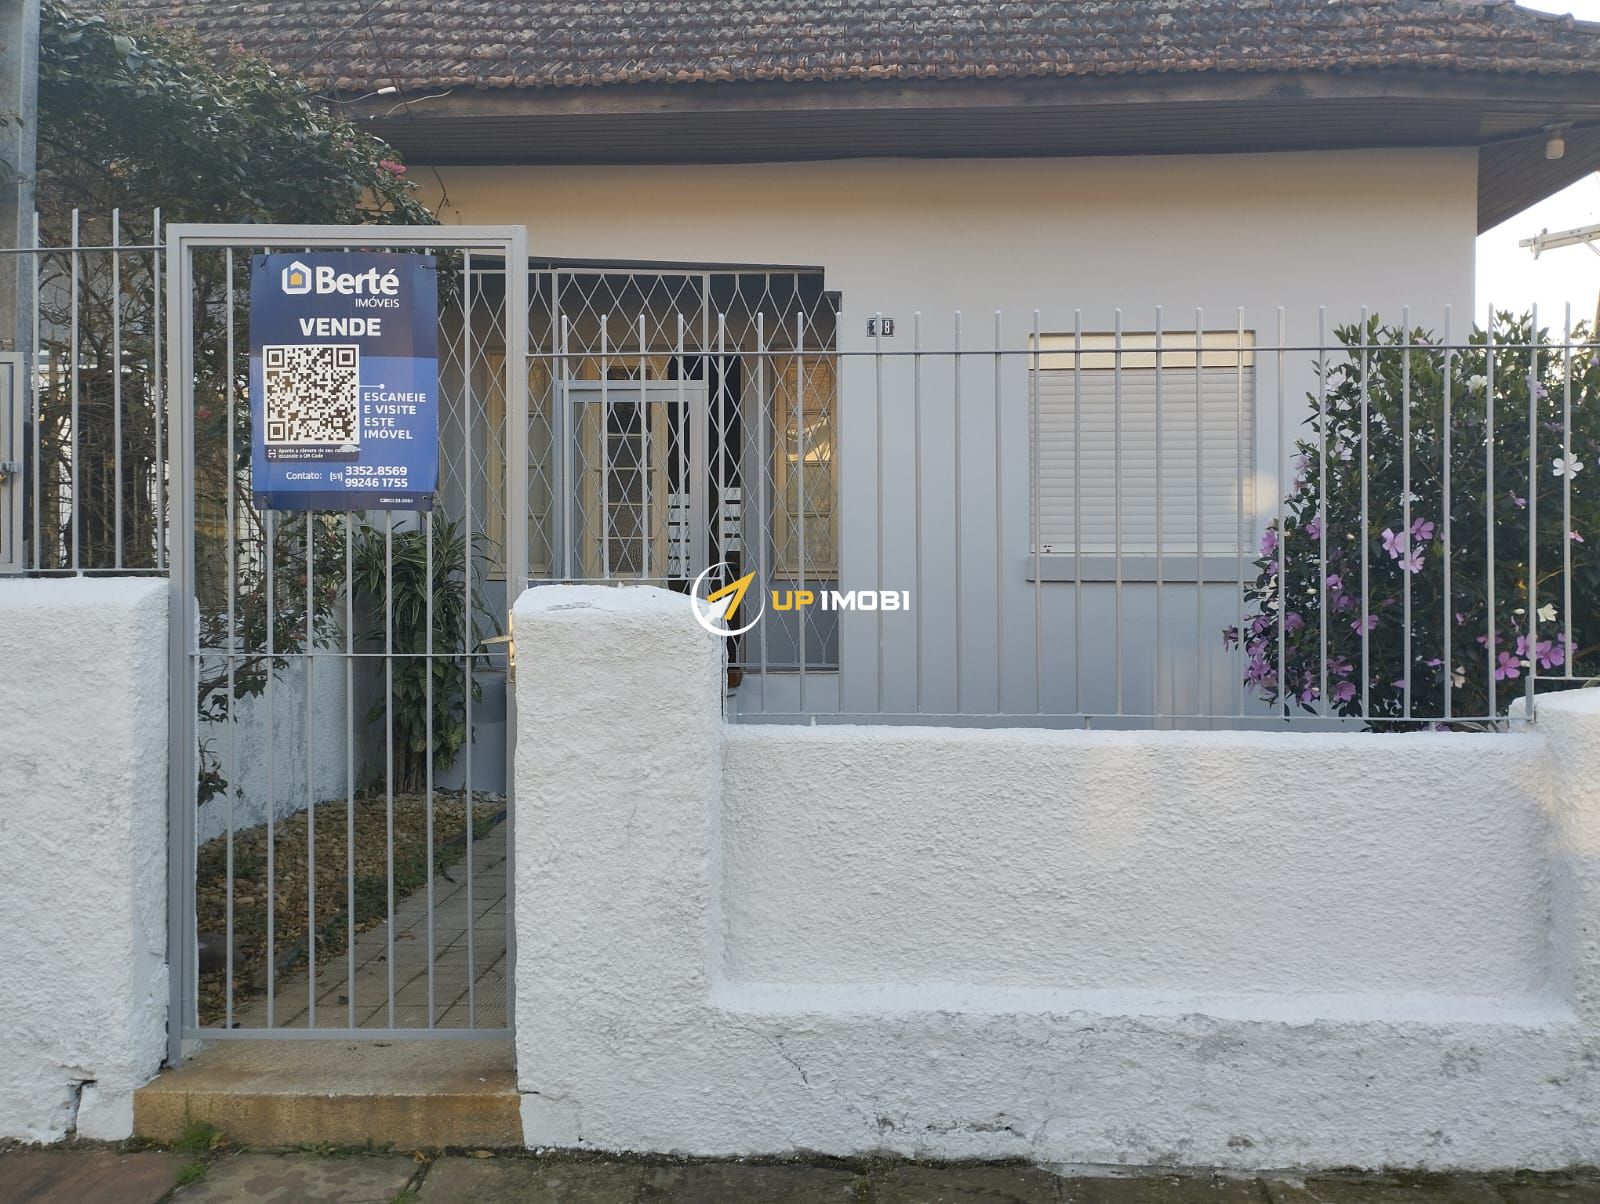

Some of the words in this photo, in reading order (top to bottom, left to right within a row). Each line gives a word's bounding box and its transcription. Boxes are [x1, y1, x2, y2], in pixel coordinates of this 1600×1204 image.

[316, 266, 400, 295] Berté
[355, 296, 400, 308] IMÓVEIS
[299, 318, 382, 337] VENDE
[364, 392, 427, 403] ESCANEIE
[364, 405, 371, 414] E
[375, 405, 417, 415] VISITE
[364, 417, 395, 427] ESTE
[364, 427, 413, 439] IMÓVEL
[286, 471, 323, 480] Contato:
[345, 466, 408, 476] 3352.8569
[345, 478, 379, 487] 99246
[382, 478, 408, 487] 1755
